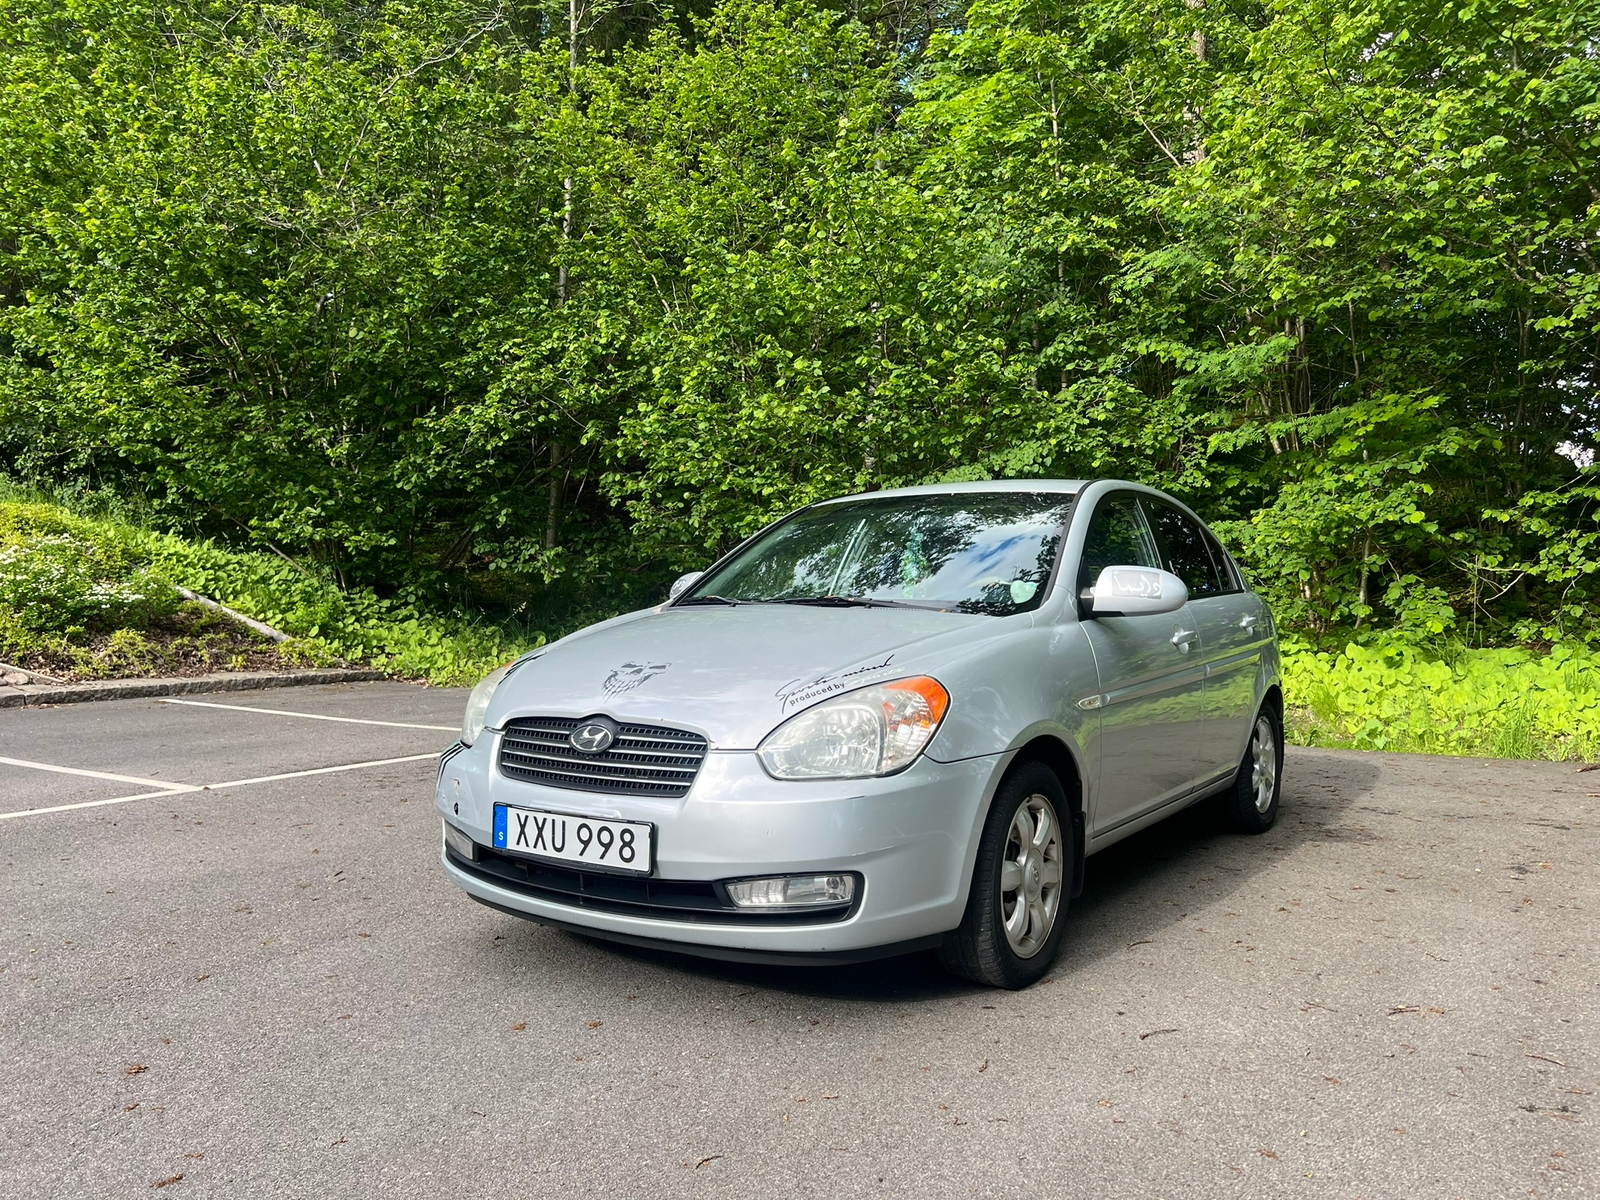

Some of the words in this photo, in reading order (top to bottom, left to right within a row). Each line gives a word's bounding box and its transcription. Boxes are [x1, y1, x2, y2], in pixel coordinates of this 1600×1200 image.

[789, 685, 833, 706] produced
[498, 831, 504, 841] S
[515, 812, 566, 853] XXU
[576, 822, 636, 864] 998
